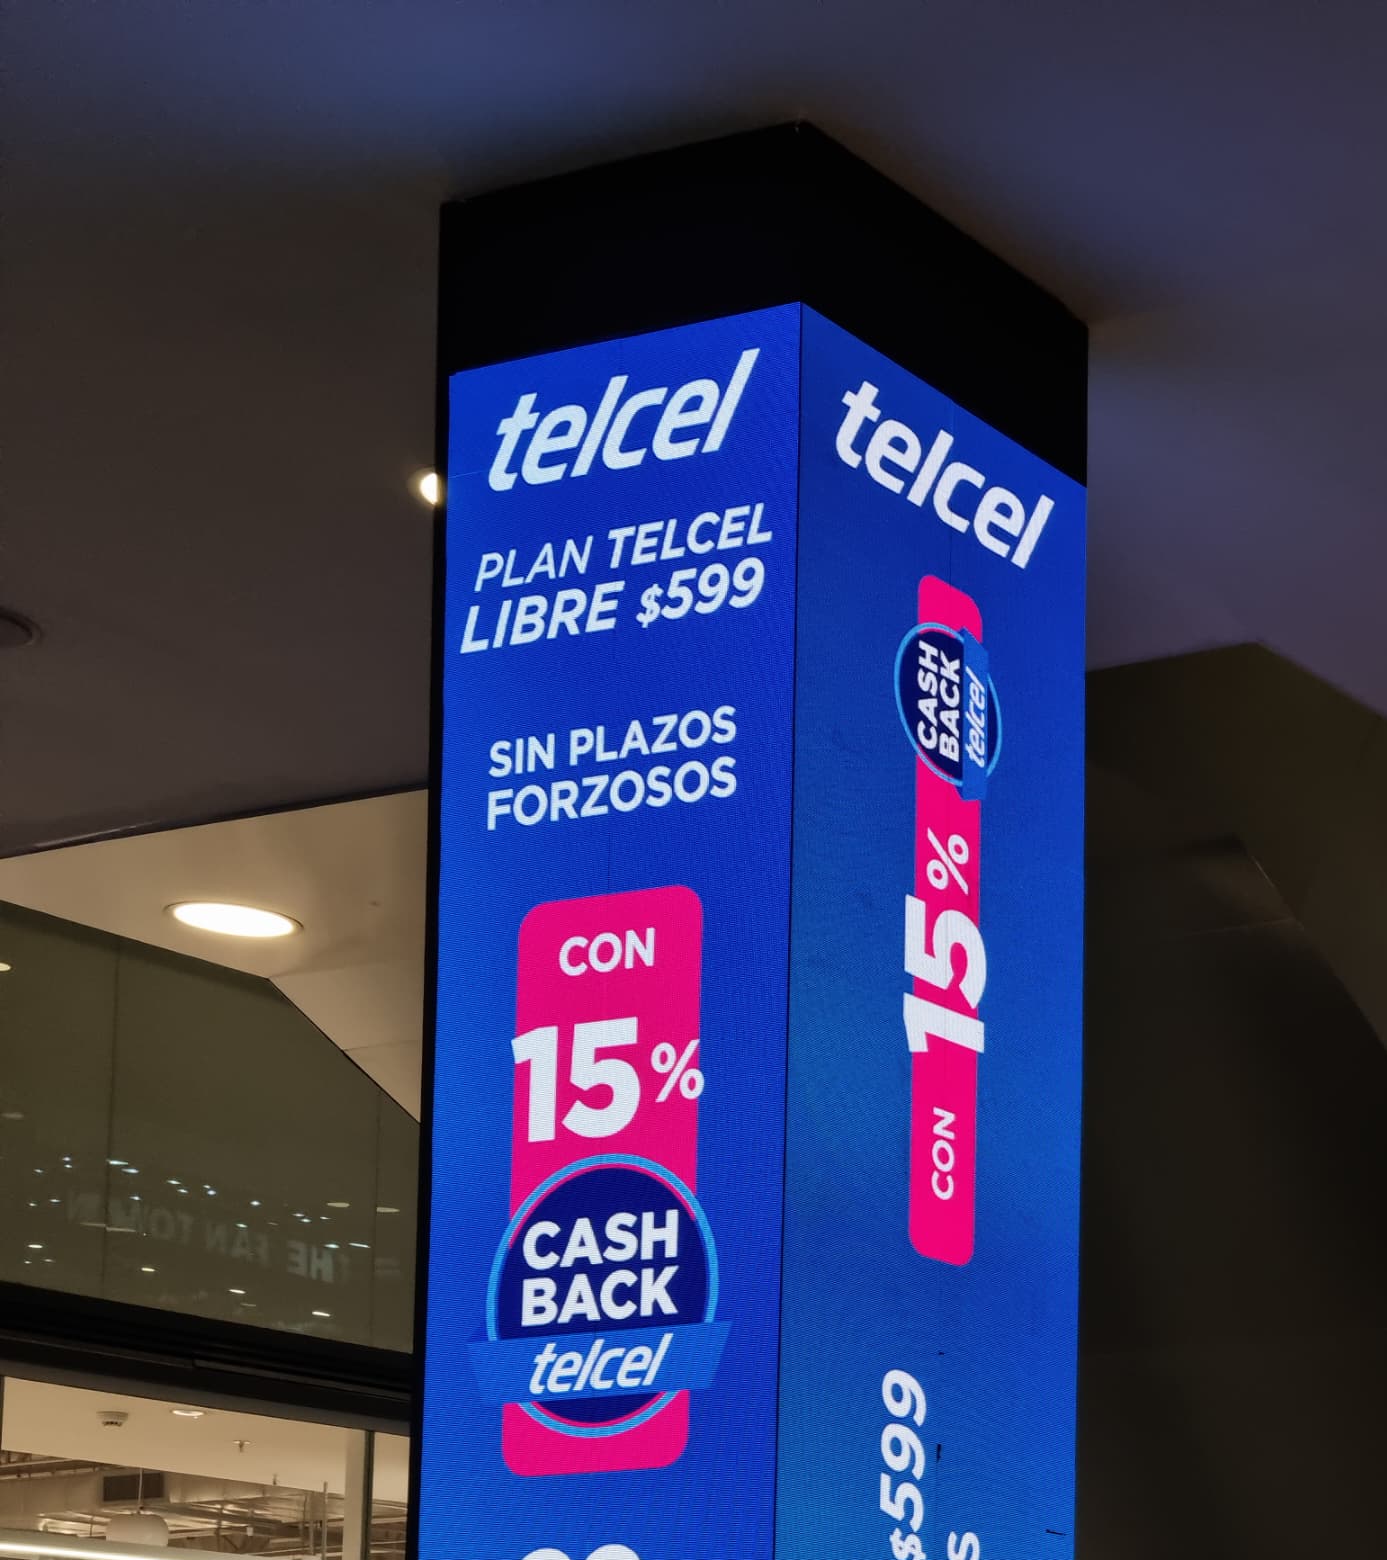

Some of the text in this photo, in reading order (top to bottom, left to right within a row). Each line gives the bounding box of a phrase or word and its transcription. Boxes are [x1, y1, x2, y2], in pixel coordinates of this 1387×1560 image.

[489, 348, 761, 492] telcel
[835, 381, 1055, 569] telcel
[474, 503, 773, 592] PLAN TELCEL
[460, 557, 765, 654] LIBRE $599
[488, 705, 737, 778] SIN PLAZOS
[916, 640, 940, 751] CASH
[938, 657, 962, 763] BACK
[964, 666, 987, 768] telcel
[487, 756, 737, 831] FORZOSOS
[559, 927, 656, 976] CON
[511, 1016, 705, 1143] 15%
[931, 1107, 956, 1201] CON
[522, 1209, 680, 1271] CASH
[521, 1265, 679, 1327] BACK
[529, 1333, 674, 1394] telcel
